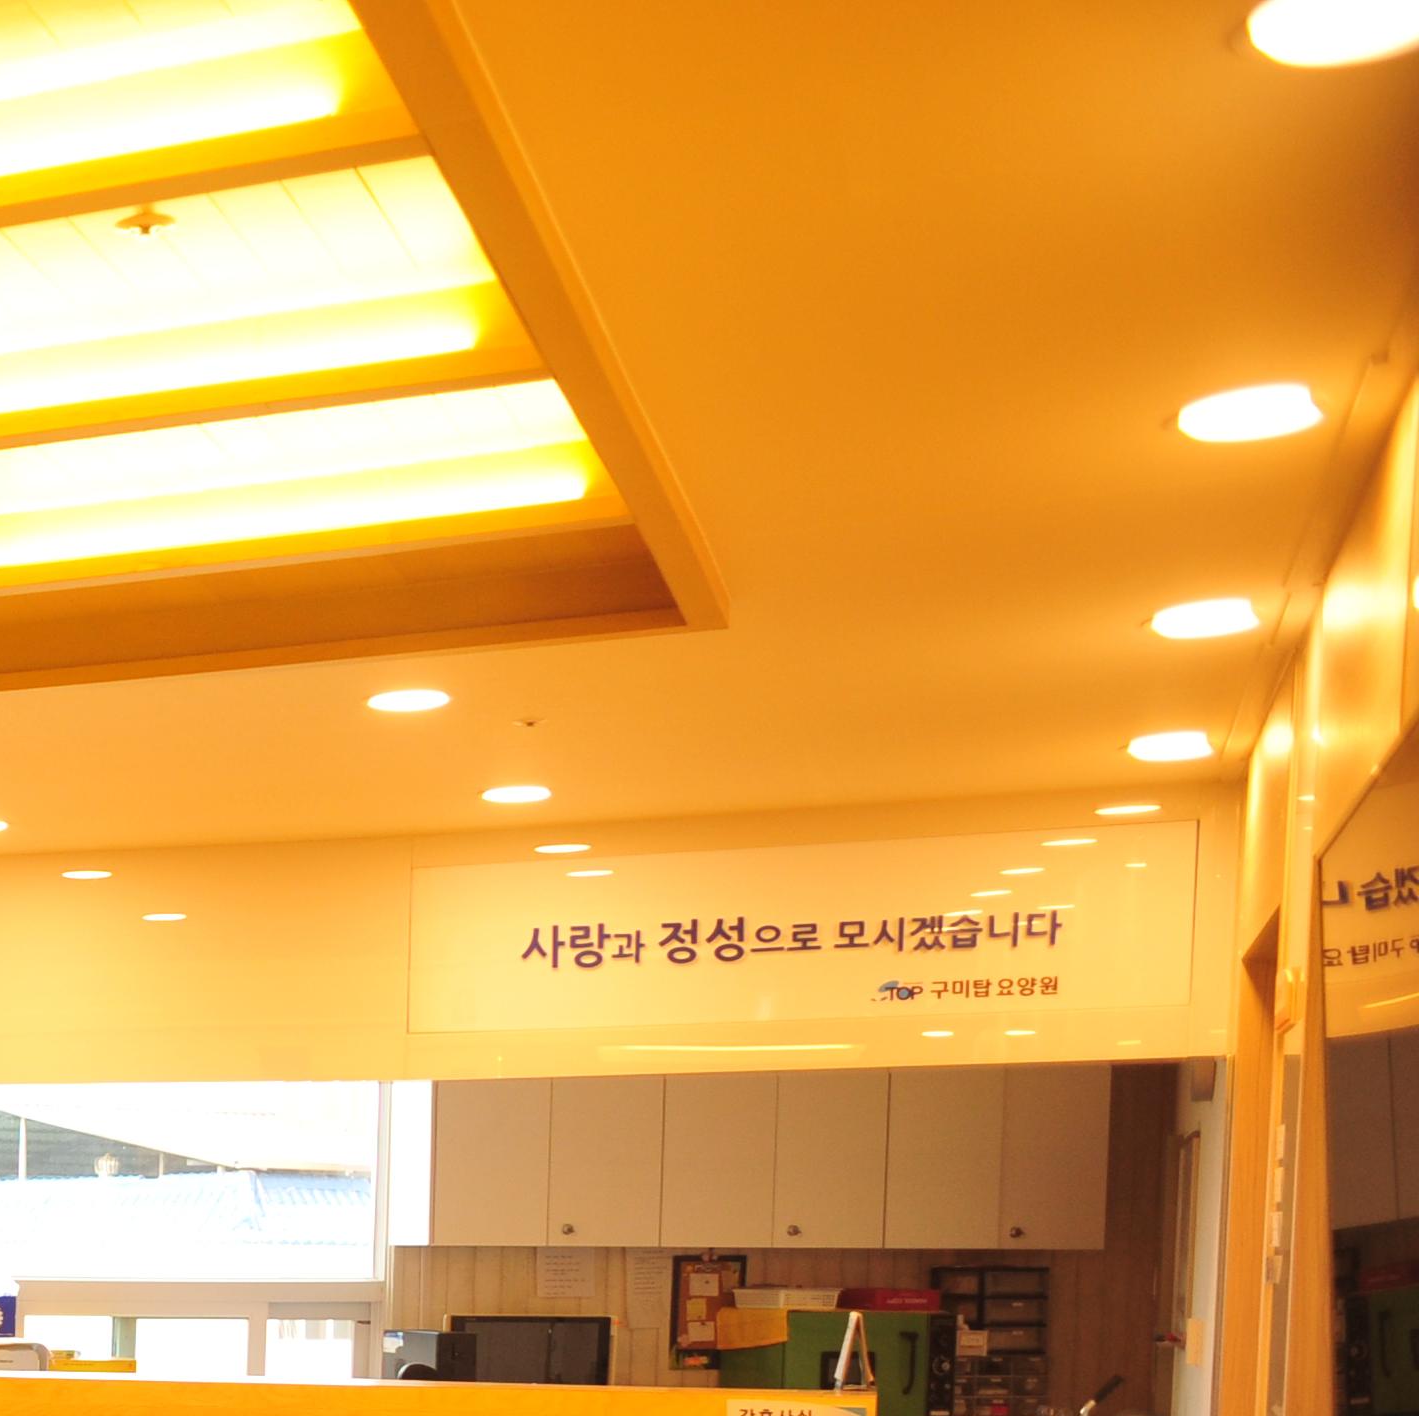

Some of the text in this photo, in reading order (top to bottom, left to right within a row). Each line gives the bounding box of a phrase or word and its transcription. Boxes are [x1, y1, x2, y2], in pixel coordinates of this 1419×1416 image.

[521, 910, 1062, 969] 사랑과 정성으로 모시겠습니다
[885, 976, 1059, 1001] TOP 구미탑 요양원
